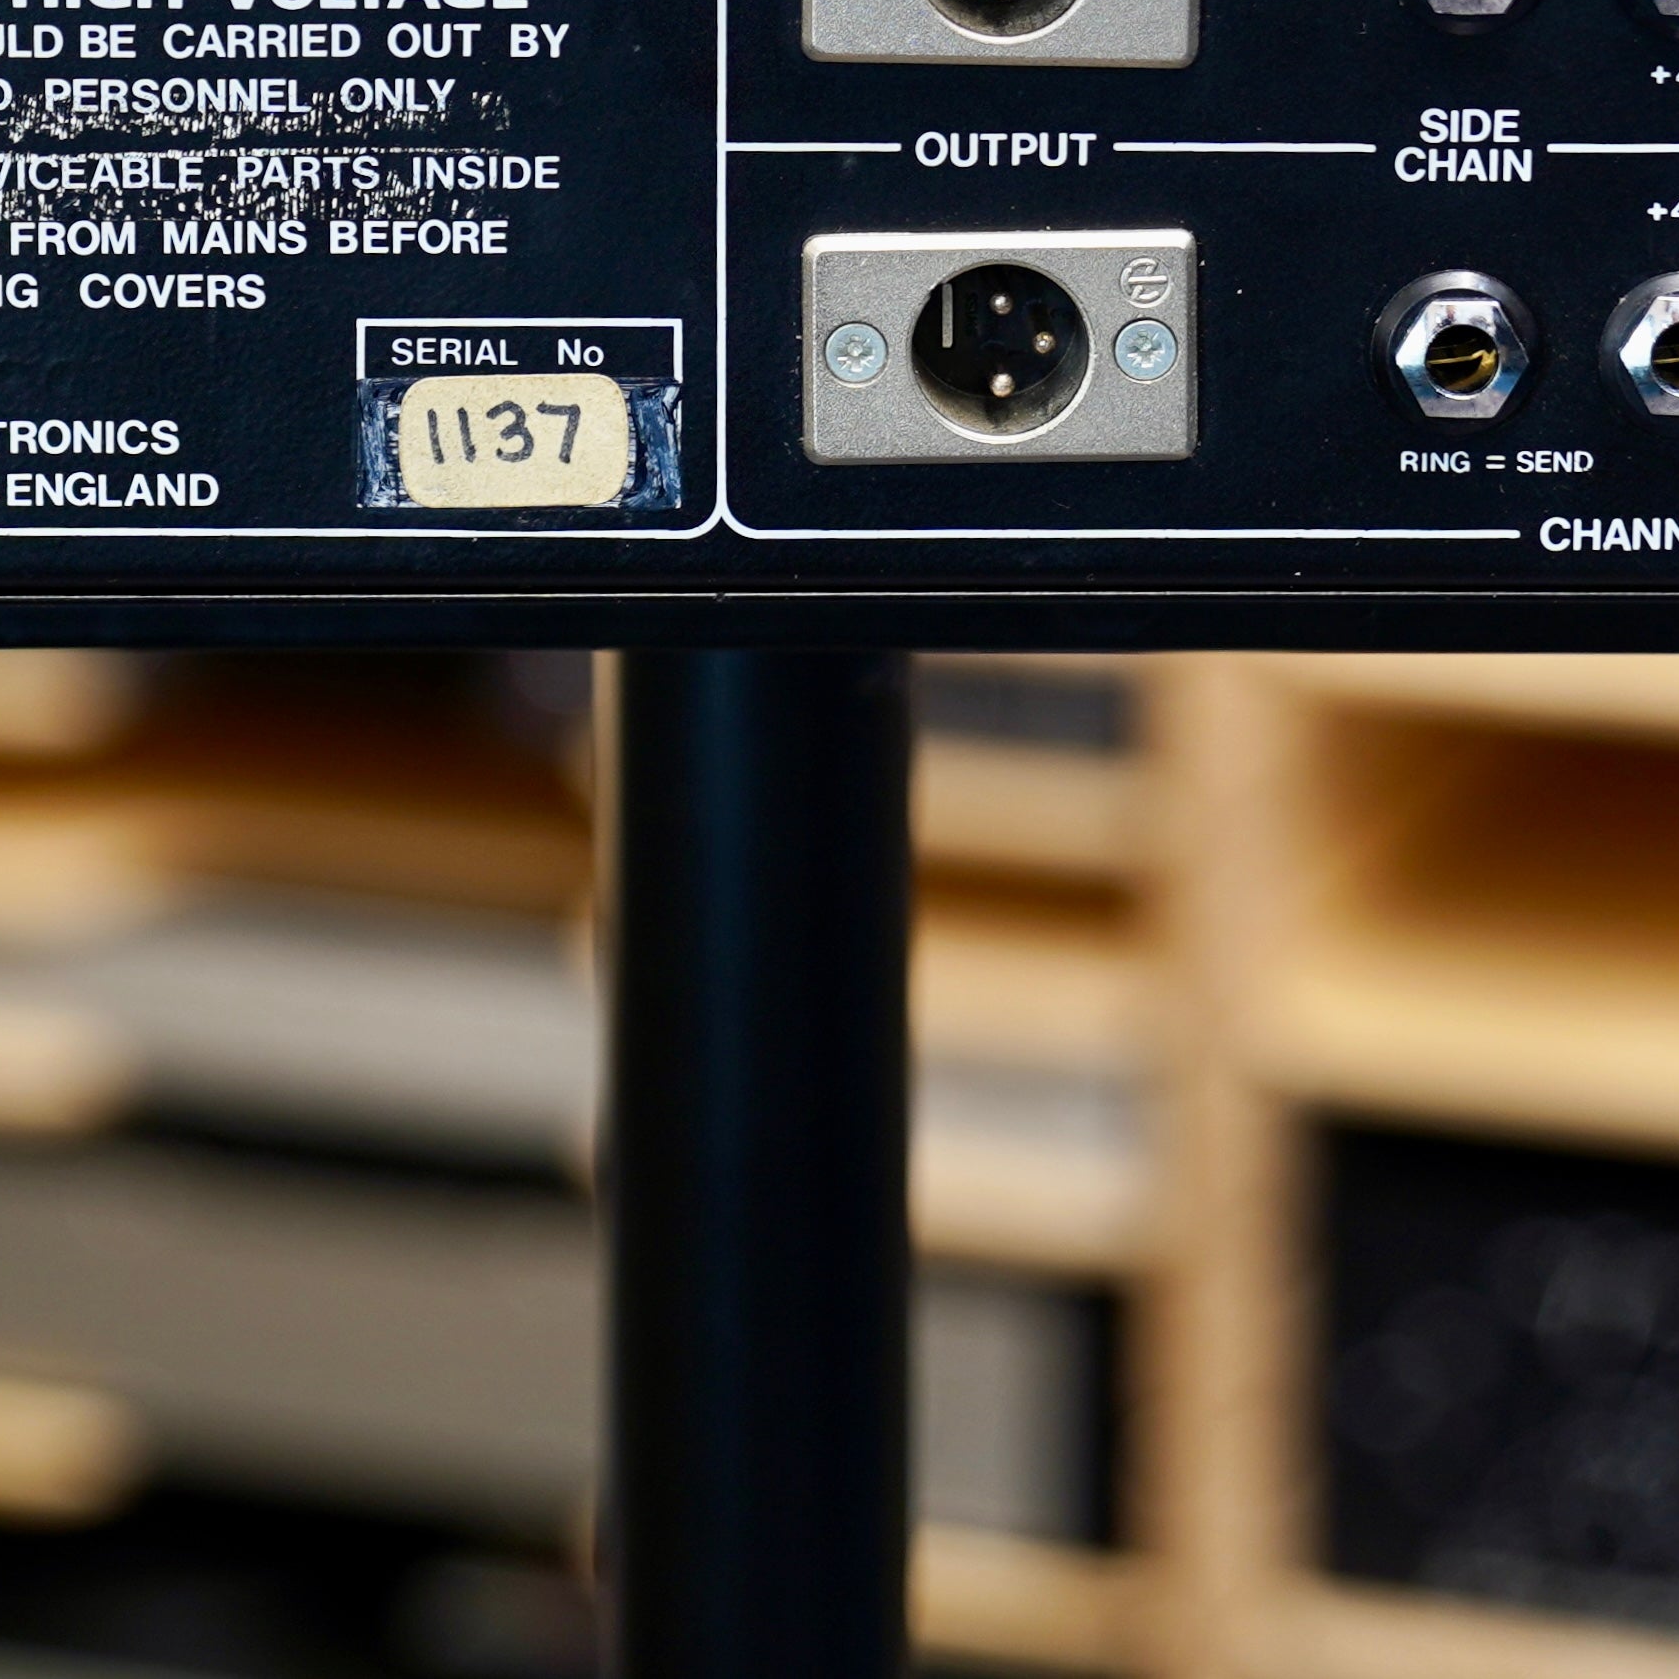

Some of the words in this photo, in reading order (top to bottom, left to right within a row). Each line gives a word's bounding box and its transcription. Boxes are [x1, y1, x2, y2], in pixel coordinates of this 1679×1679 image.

[80, 25, 136, 58] BE
[163, 24, 360, 59] CARRIED
[388, 23, 481, 58] OUT
[511, 24, 569, 58] BY
[46, 77, 311, 115] PERSONNEL
[342, 77, 456, 112] ONLY
[1420, 108, 1520, 143] SIDE
[915, 132, 1096, 167] OUTPUT
[1395, 147, 1532, 182] CHAIN
[237, 157, 380, 191] PARTS
[414, 156, 560, 190] INSIDE
[10, 221, 137, 256] FROM
[162, 221, 307, 256] MAINS
[330, 219, 508, 254] BEFORE
[80, 273, 265, 309] COVERS
[392, 338, 518, 365] SERIAL
[558, 339, 604, 366] No
[426, 402, 583, 465] 1137
[1401, 451, 1470, 473] RING
[1517, 451, 1593, 472] SEND
[7, 472, 219, 507] ENGLAND
